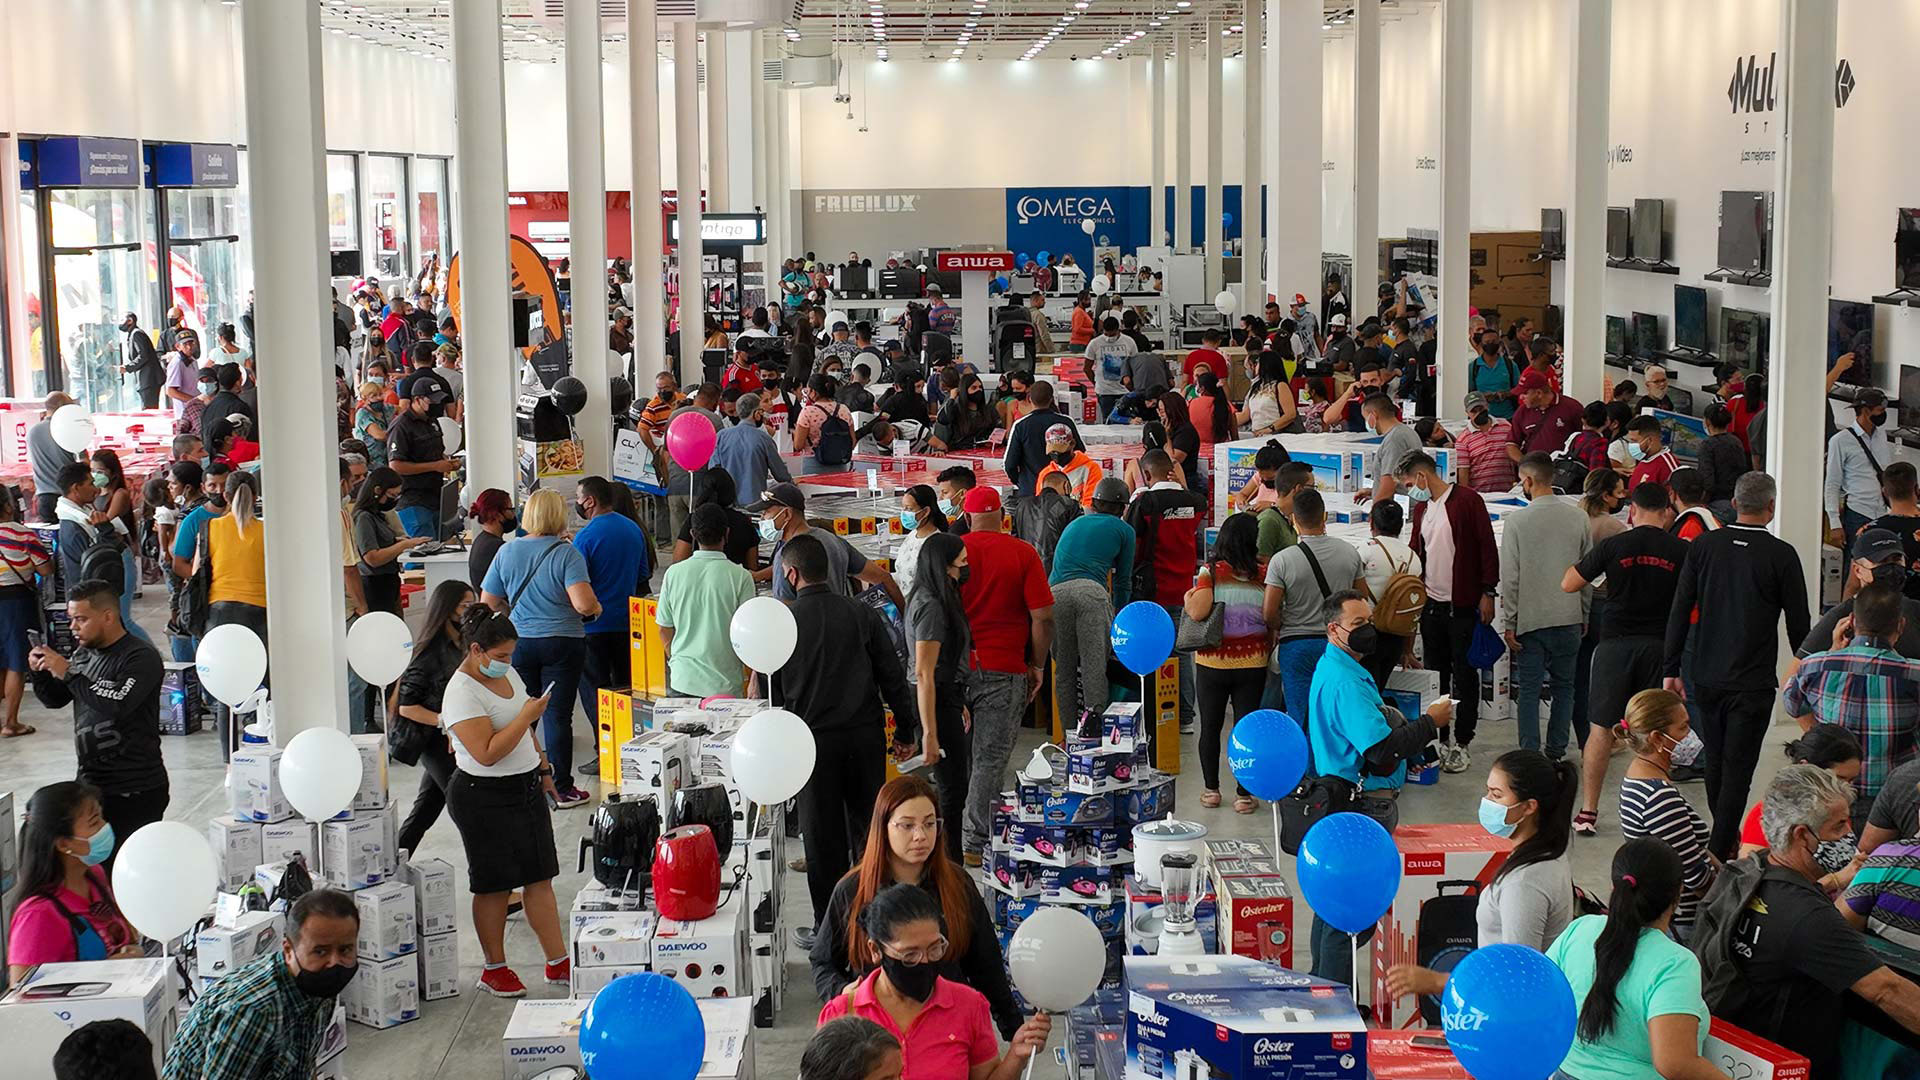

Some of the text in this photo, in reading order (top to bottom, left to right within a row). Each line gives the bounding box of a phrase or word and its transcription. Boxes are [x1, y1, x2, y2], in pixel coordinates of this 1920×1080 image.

[815, 195, 916, 213] FRIGILUX
[1022, 196, 1115, 217] OMEGA
[701, 222, 744, 237] ntigo
[947, 256, 1006, 268] aiwa
[1230, 480, 1245, 488] FHD
[1046, 797, 1069, 808] Oster
[1010, 823, 1025, 834] Oster
[1407, 860, 1442, 869] aiwa
[1042, 869, 1061, 878] Oster
[1006, 900, 1026, 911] Oster
[1240, 902, 1285, 919] Osterizer
[1094, 908, 1116, 921] Oster
[657, 942, 707, 952] DAEWOO
[510, 1045, 566, 1056] DAEWOO
[1253, 1037, 1295, 1055] Oster
[1777, 1067, 1807, 1077] aiwa
